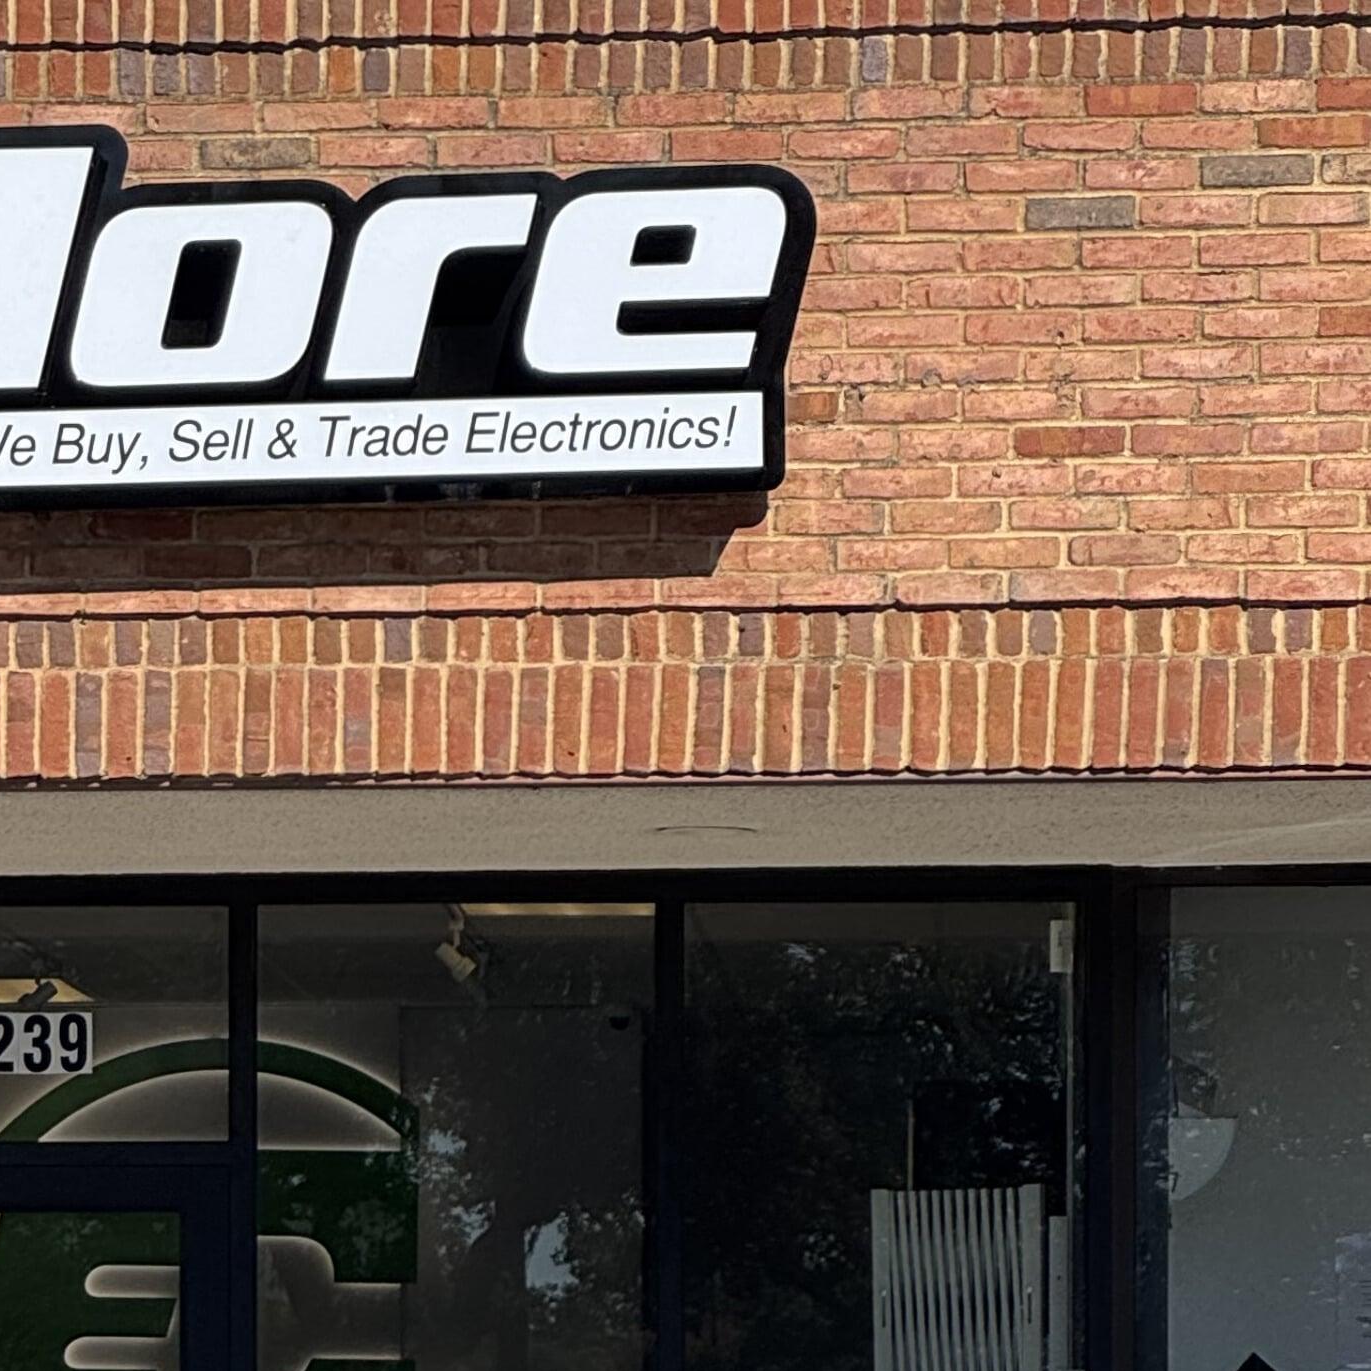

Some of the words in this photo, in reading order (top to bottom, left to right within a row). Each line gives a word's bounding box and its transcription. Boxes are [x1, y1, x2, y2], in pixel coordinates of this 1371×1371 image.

[51, 422, 149, 476] Buy,
[167, 417, 254, 463] Sell
[266, 417, 297, 460] &
[318, 412, 449, 458] Trade
[464, 404, 739, 455] Electronics!
